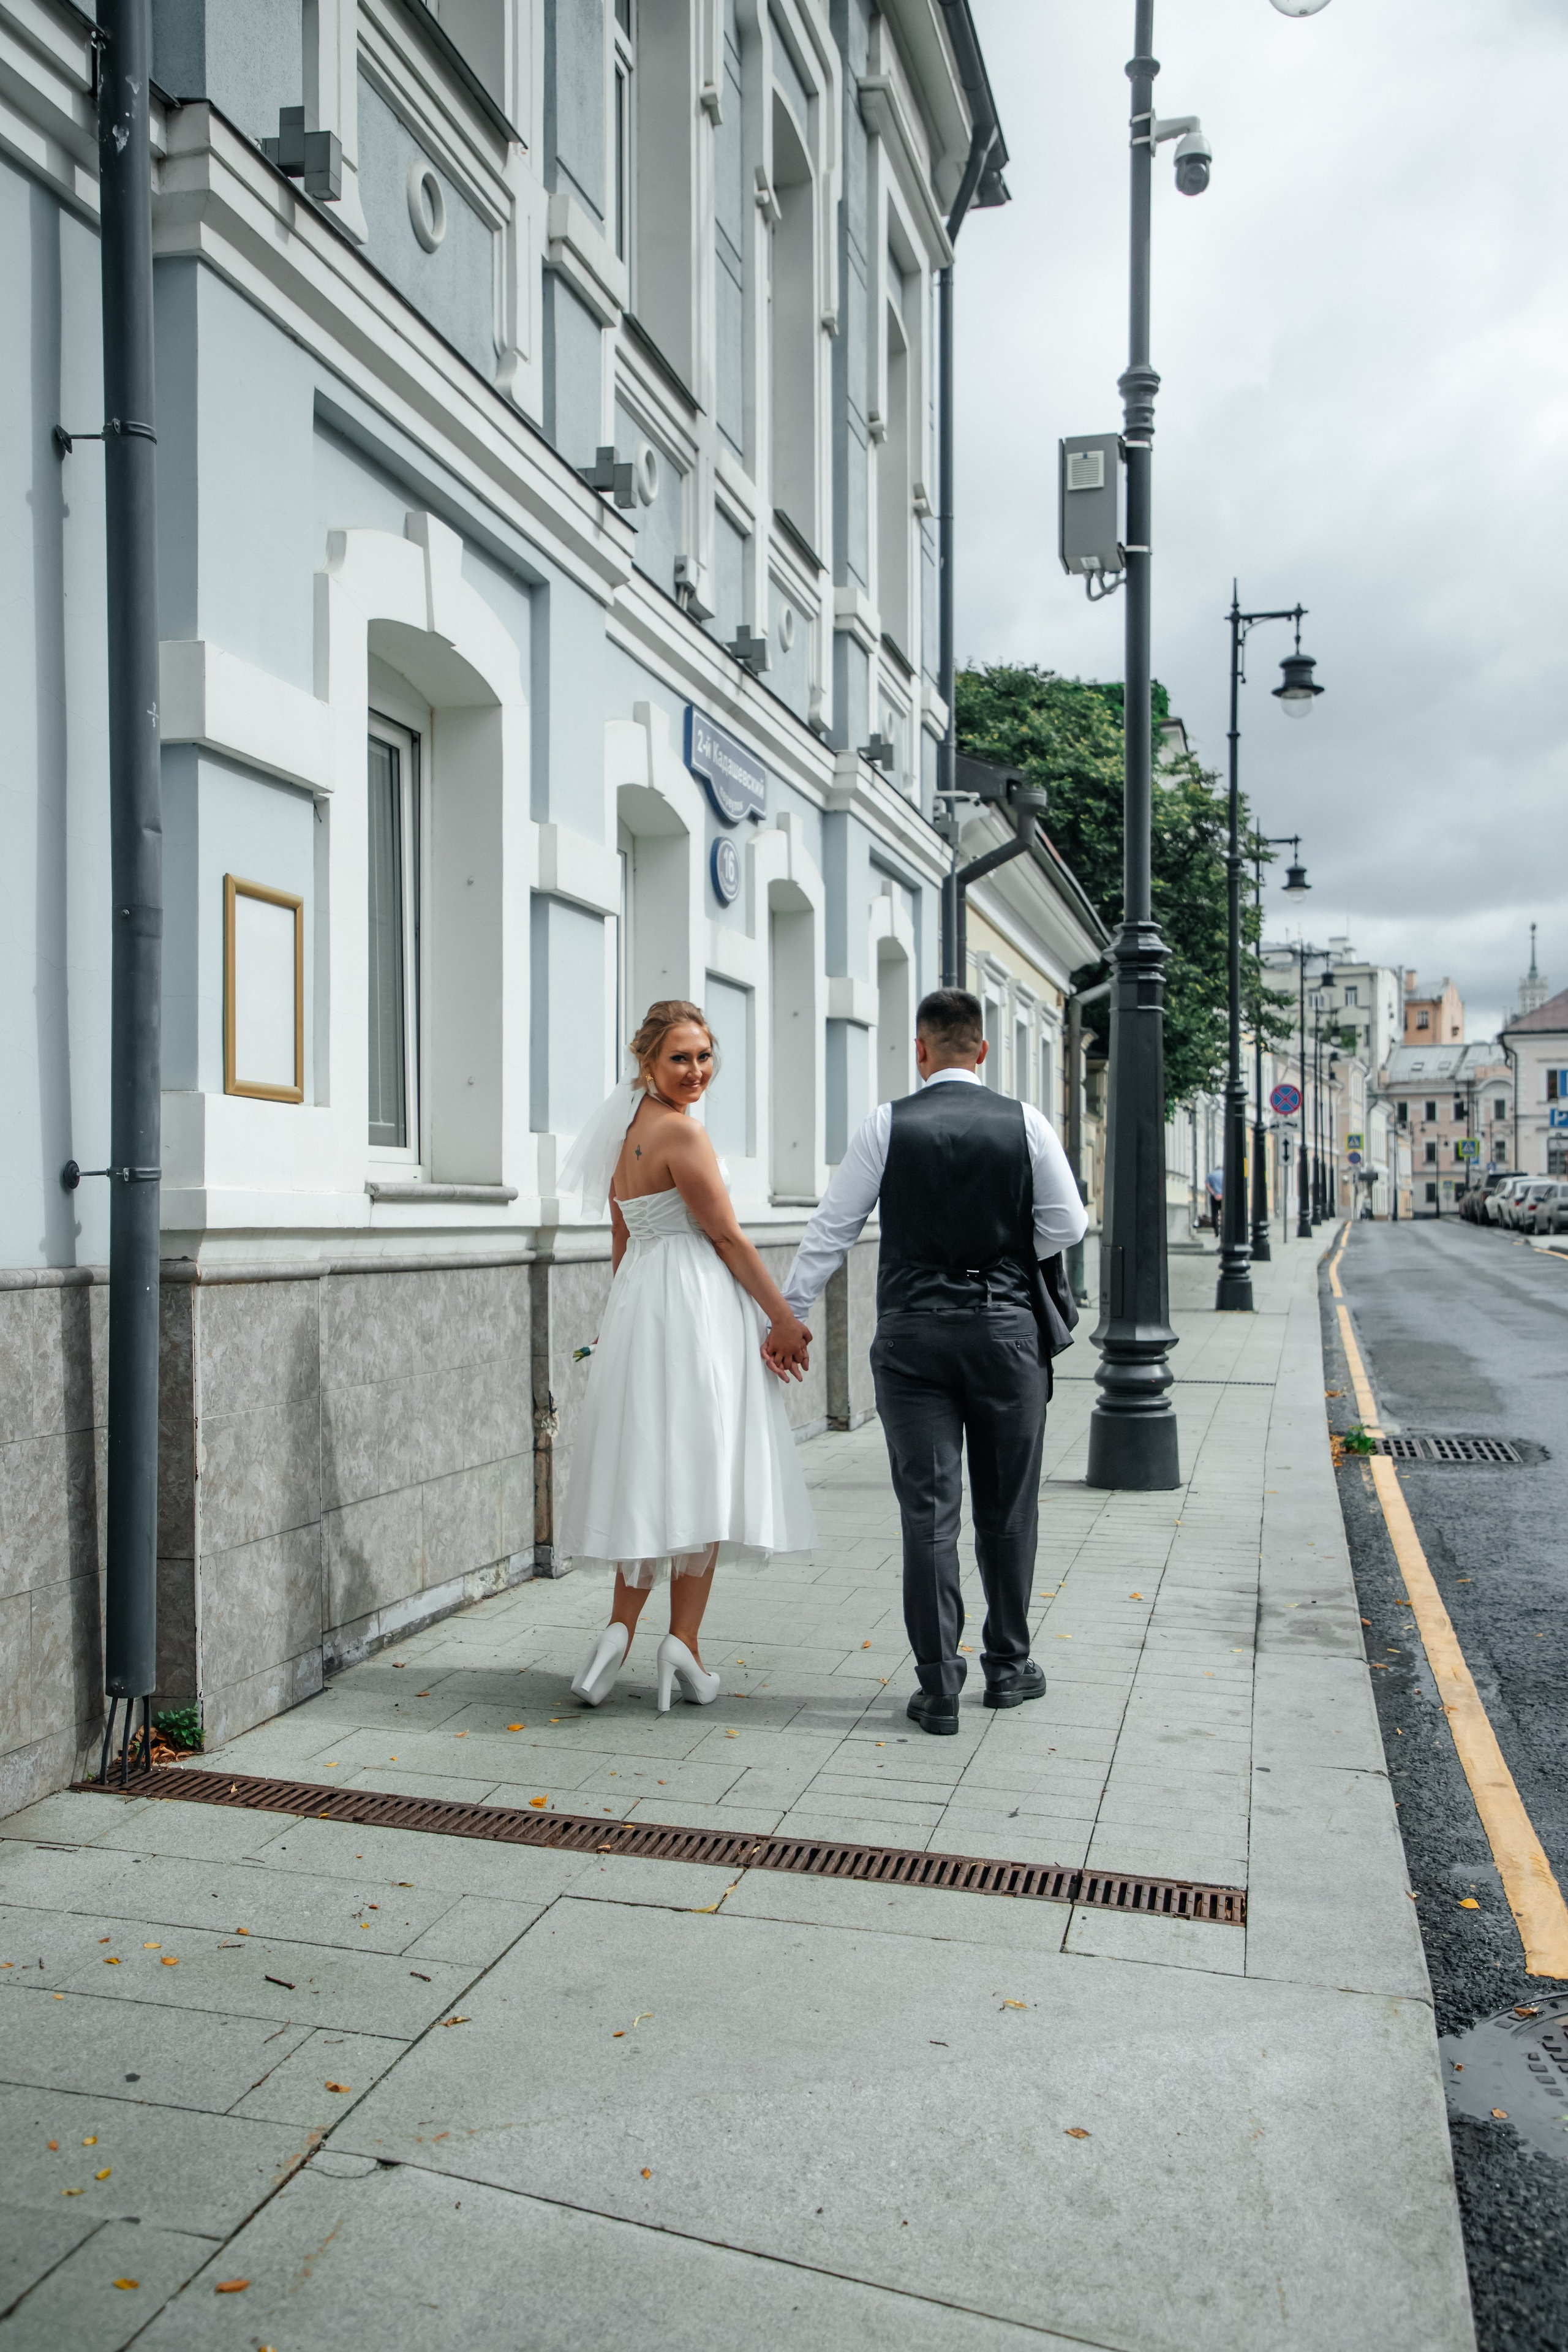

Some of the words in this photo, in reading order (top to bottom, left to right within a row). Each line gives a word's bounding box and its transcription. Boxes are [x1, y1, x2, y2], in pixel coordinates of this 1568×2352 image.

[697, 729, 711, 759] 2-й
[713, 741, 764, 800] Кадашевский
[723, 847, 734, 883] 16
